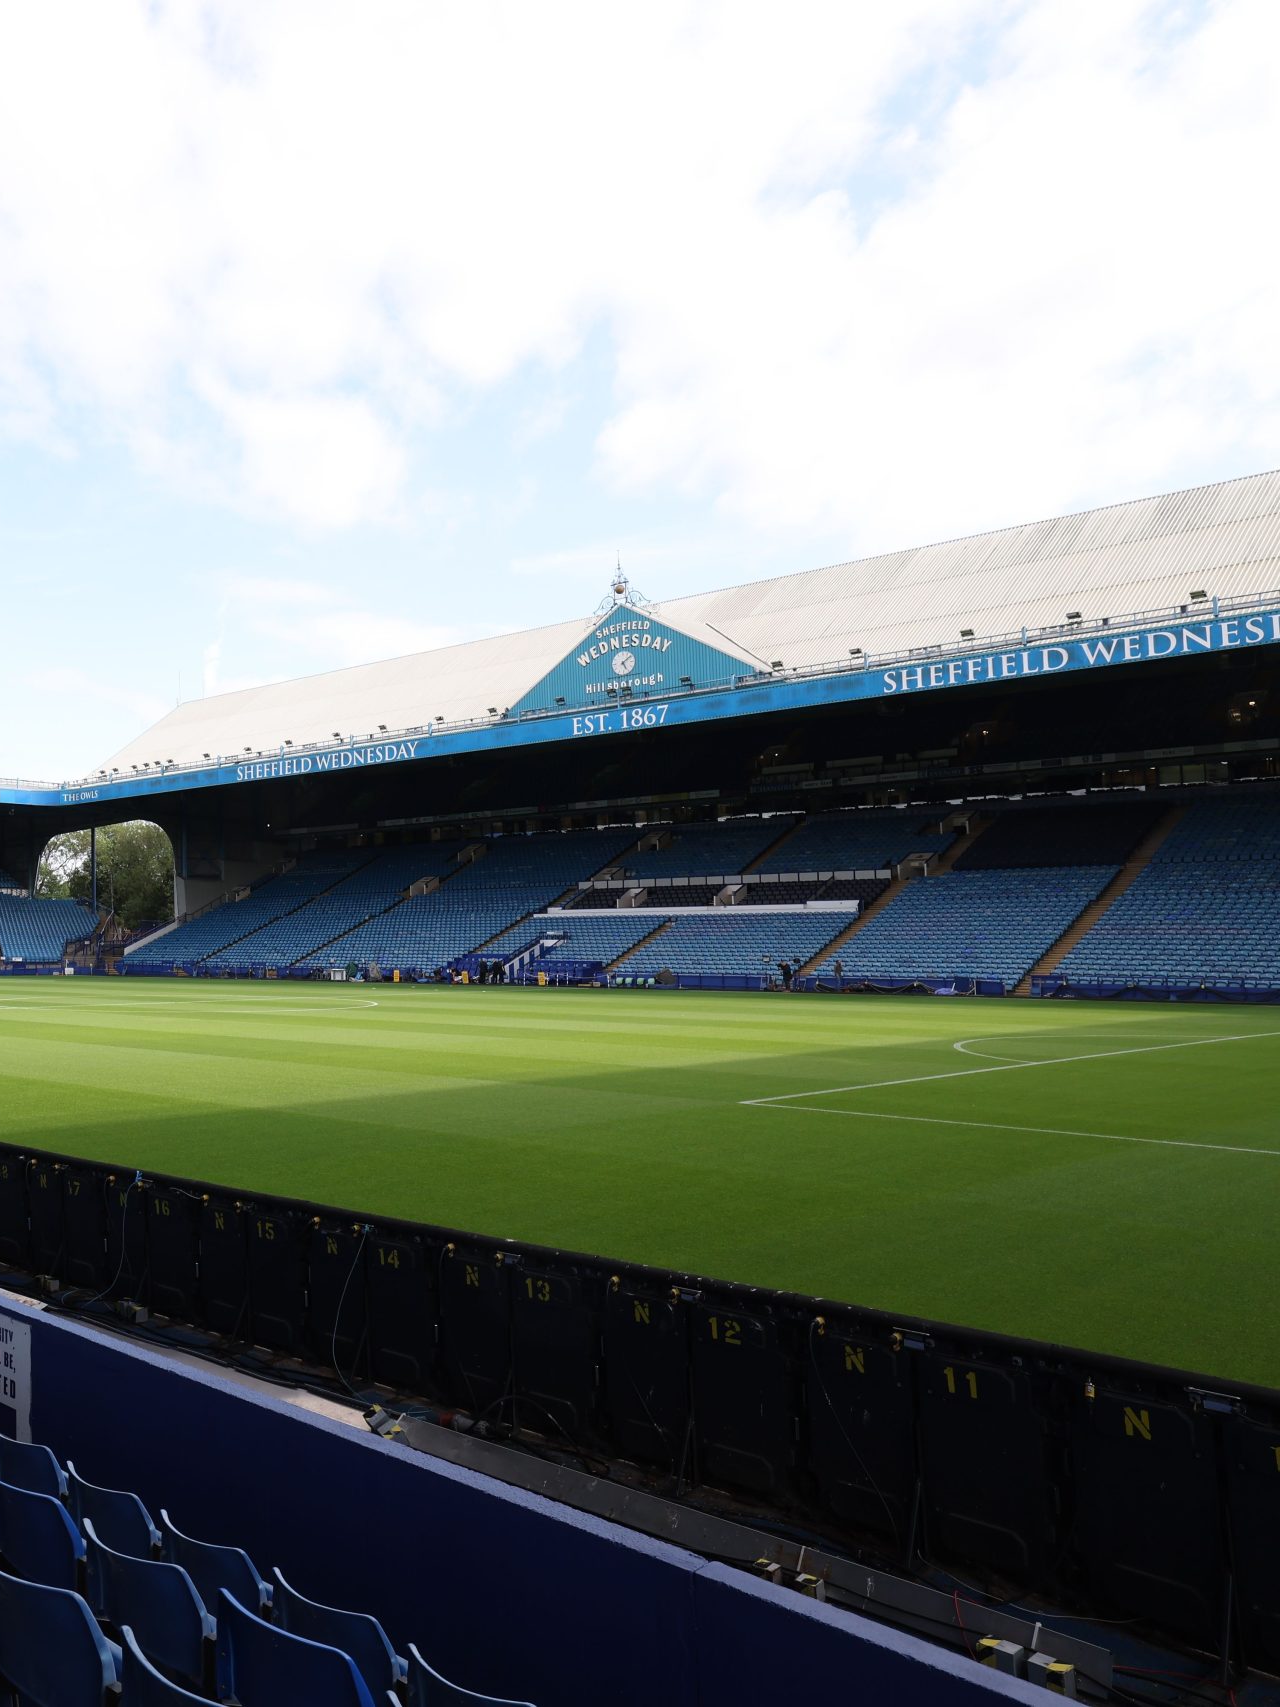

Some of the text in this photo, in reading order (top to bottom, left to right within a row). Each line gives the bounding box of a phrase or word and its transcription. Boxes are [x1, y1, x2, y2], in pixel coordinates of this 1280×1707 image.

[596, 620, 650, 639] SHEFFIELD
[577, 633, 672, 668] WEDNESDAY
[883, 647, 1068, 694] SHEFFIELD
[585, 672, 664, 694] Hillsborough
[572, 704, 669, 736] EST. 1867
[236, 741, 419, 781] SHEFFIELD WEDNESDAY
[62, 790, 99, 802] THE OWLS
[40, 1174, 48, 1188] N
[67, 1180, 81, 1196] 17
[119, 1191, 127, 1207] N
[153, 1199, 170, 1217] 16
[214, 1211, 225, 1231] N
[256, 1221, 275, 1240] 15
[327, 1235, 338, 1255] N
[378, 1247, 400, 1269] 14
[464, 1264, 480, 1287] N
[524, 1276, 551, 1302] 13
[633, 1300, 651, 1324] N
[708, 1316, 741, 1345] 12
[3, 1351, 16, 1373] BE,
[844, 1345, 865, 1374] N
[943, 1367, 978, 1399] 11
[1124, 1406, 1153, 1441] N
